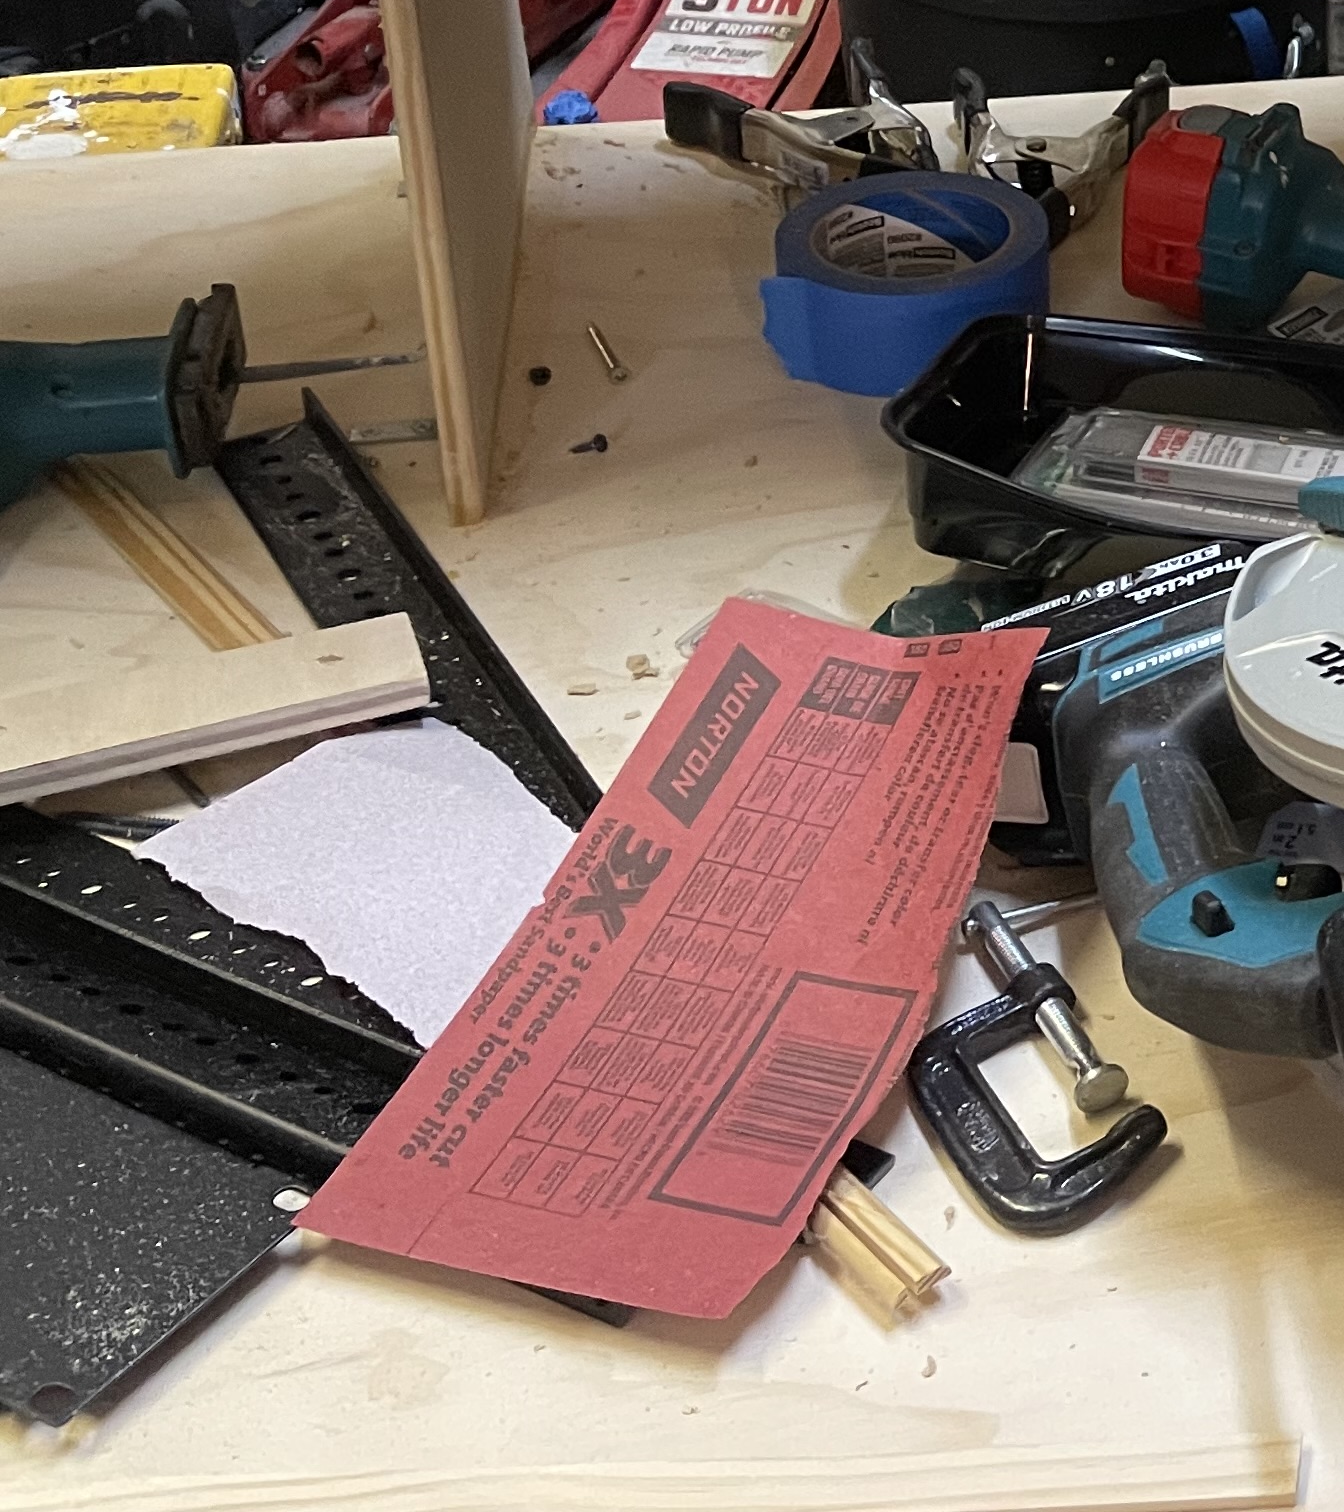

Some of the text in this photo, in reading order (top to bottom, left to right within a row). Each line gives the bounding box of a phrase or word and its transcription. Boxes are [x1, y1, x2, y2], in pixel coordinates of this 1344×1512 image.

[668, 19, 714, 34] LOW
[1124, 555, 1246, 604] makita
[1110, 632, 1223, 682] BRUSHLESS
[671, 671, 759, 799] NORTON
[470, 816, 620, 1025] World's Best Sandpaper
[563, 824, 673, 945] 3X
[398, 937, 568, 1161] 3 times longer life
[428, 952, 593, 1169] 3 times faster cut
